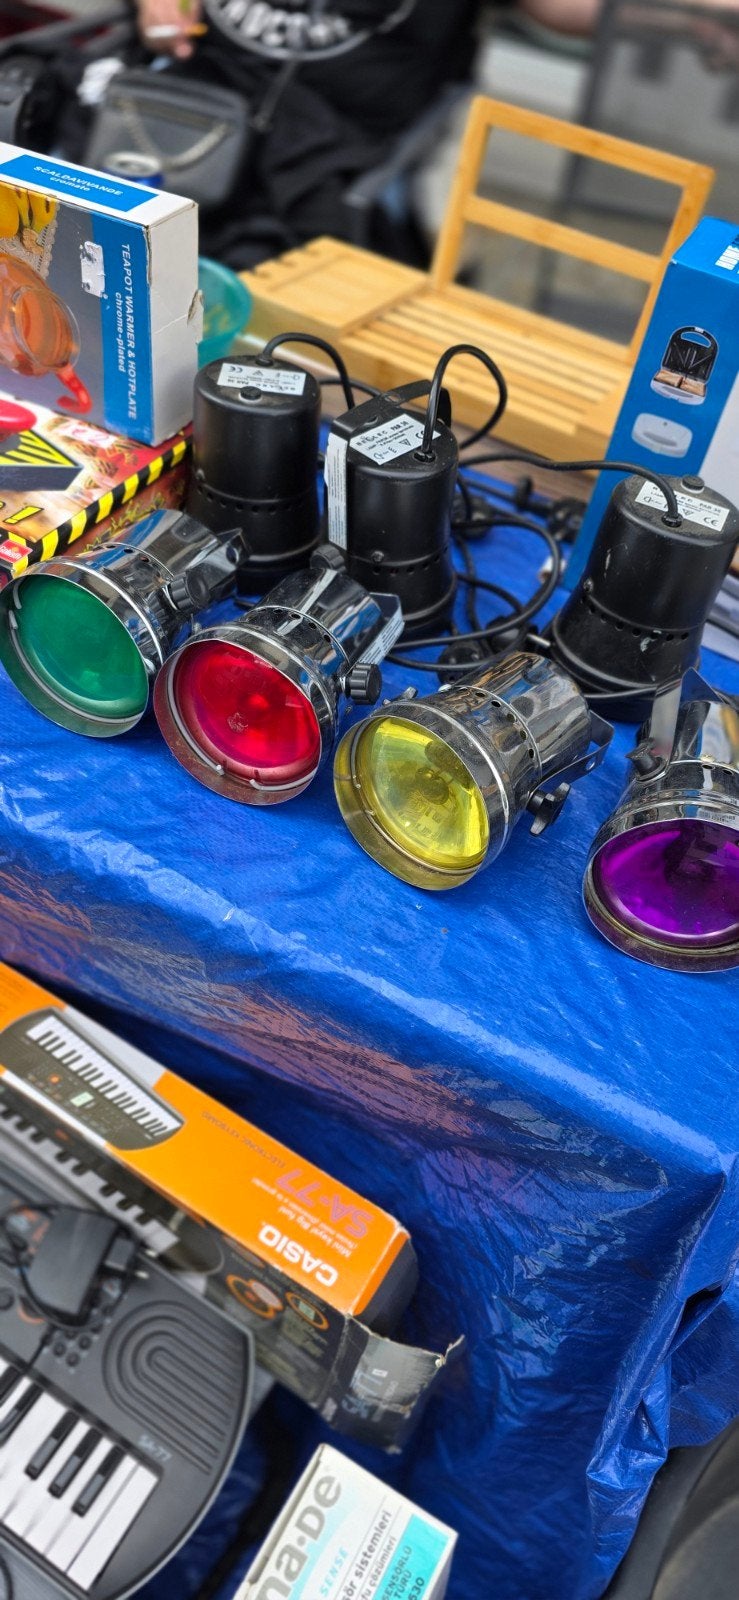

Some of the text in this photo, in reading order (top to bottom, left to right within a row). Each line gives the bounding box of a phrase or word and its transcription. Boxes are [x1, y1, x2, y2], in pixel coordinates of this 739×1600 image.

[33, 166, 124, 196] SCALDAVIVANDE
[115, 291, 126, 373] chrome-plated
[121, 243, 137, 420] TEAPOT WARMER & HOTPLATE
[275, 1168, 374, 1239] SA-77
[257, 1223, 339, 1288] CASIO
[333, 1240, 353, 1258] Mini
[319, 1547, 349, 1598] SENSE
[354, 1510, 393, 1580] sistemleri
[370, 1536, 397, 1587] çözümleri
